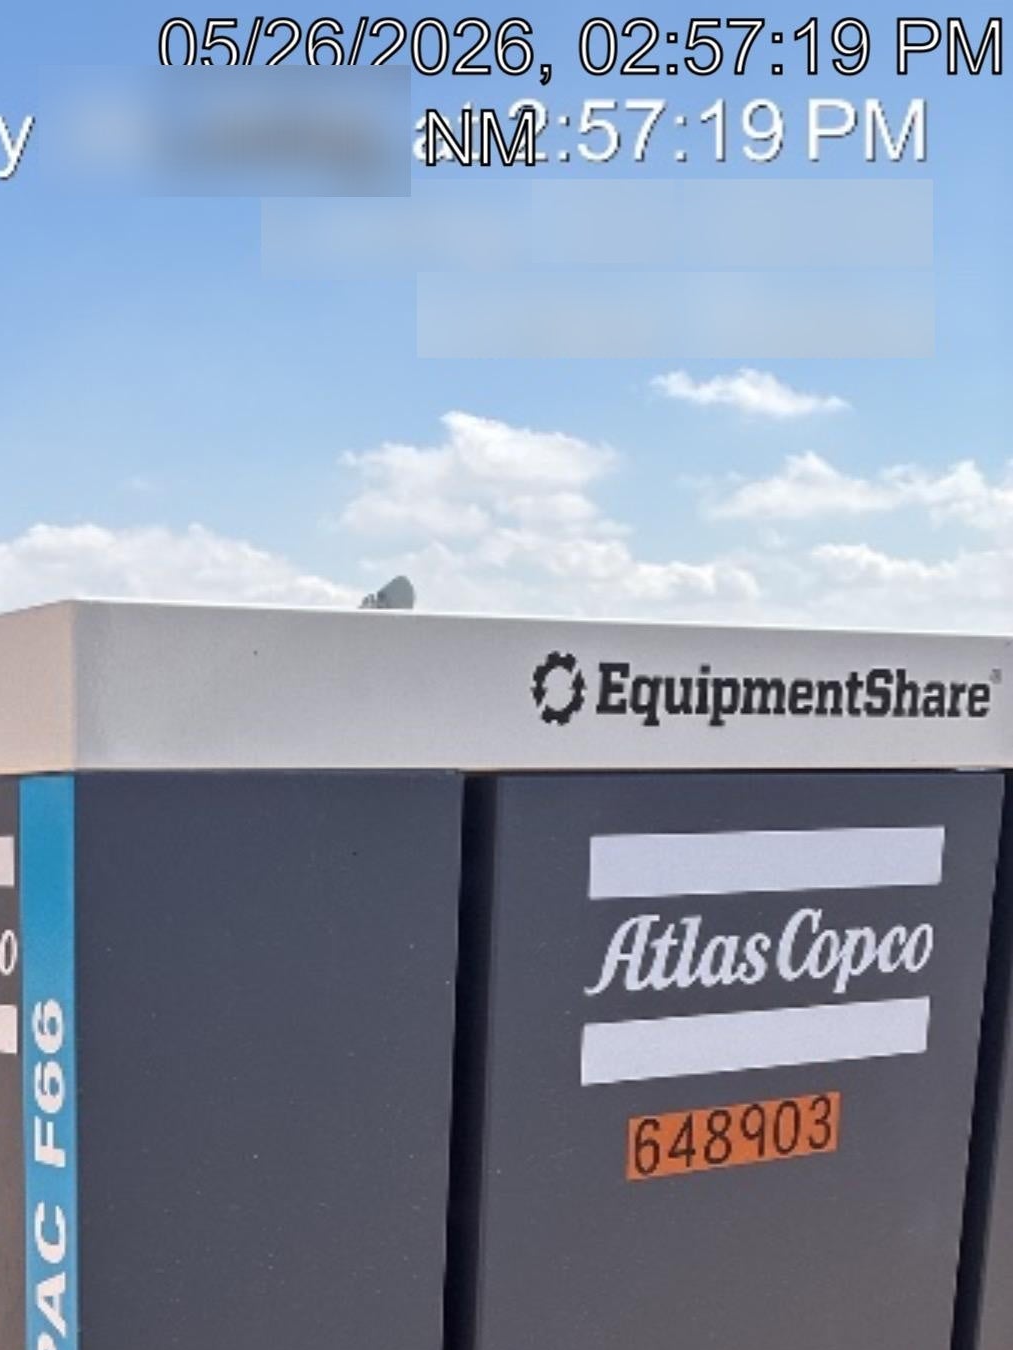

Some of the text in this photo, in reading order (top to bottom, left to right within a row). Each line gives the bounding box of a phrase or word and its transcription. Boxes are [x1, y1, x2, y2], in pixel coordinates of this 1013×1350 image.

[596, 661, 992, 727] EquipmentShare
[584, 907, 934, 996] Atlas Copco
[31, 997, 67, 1168] F66
[633, 1095, 833, 1176] 648903
